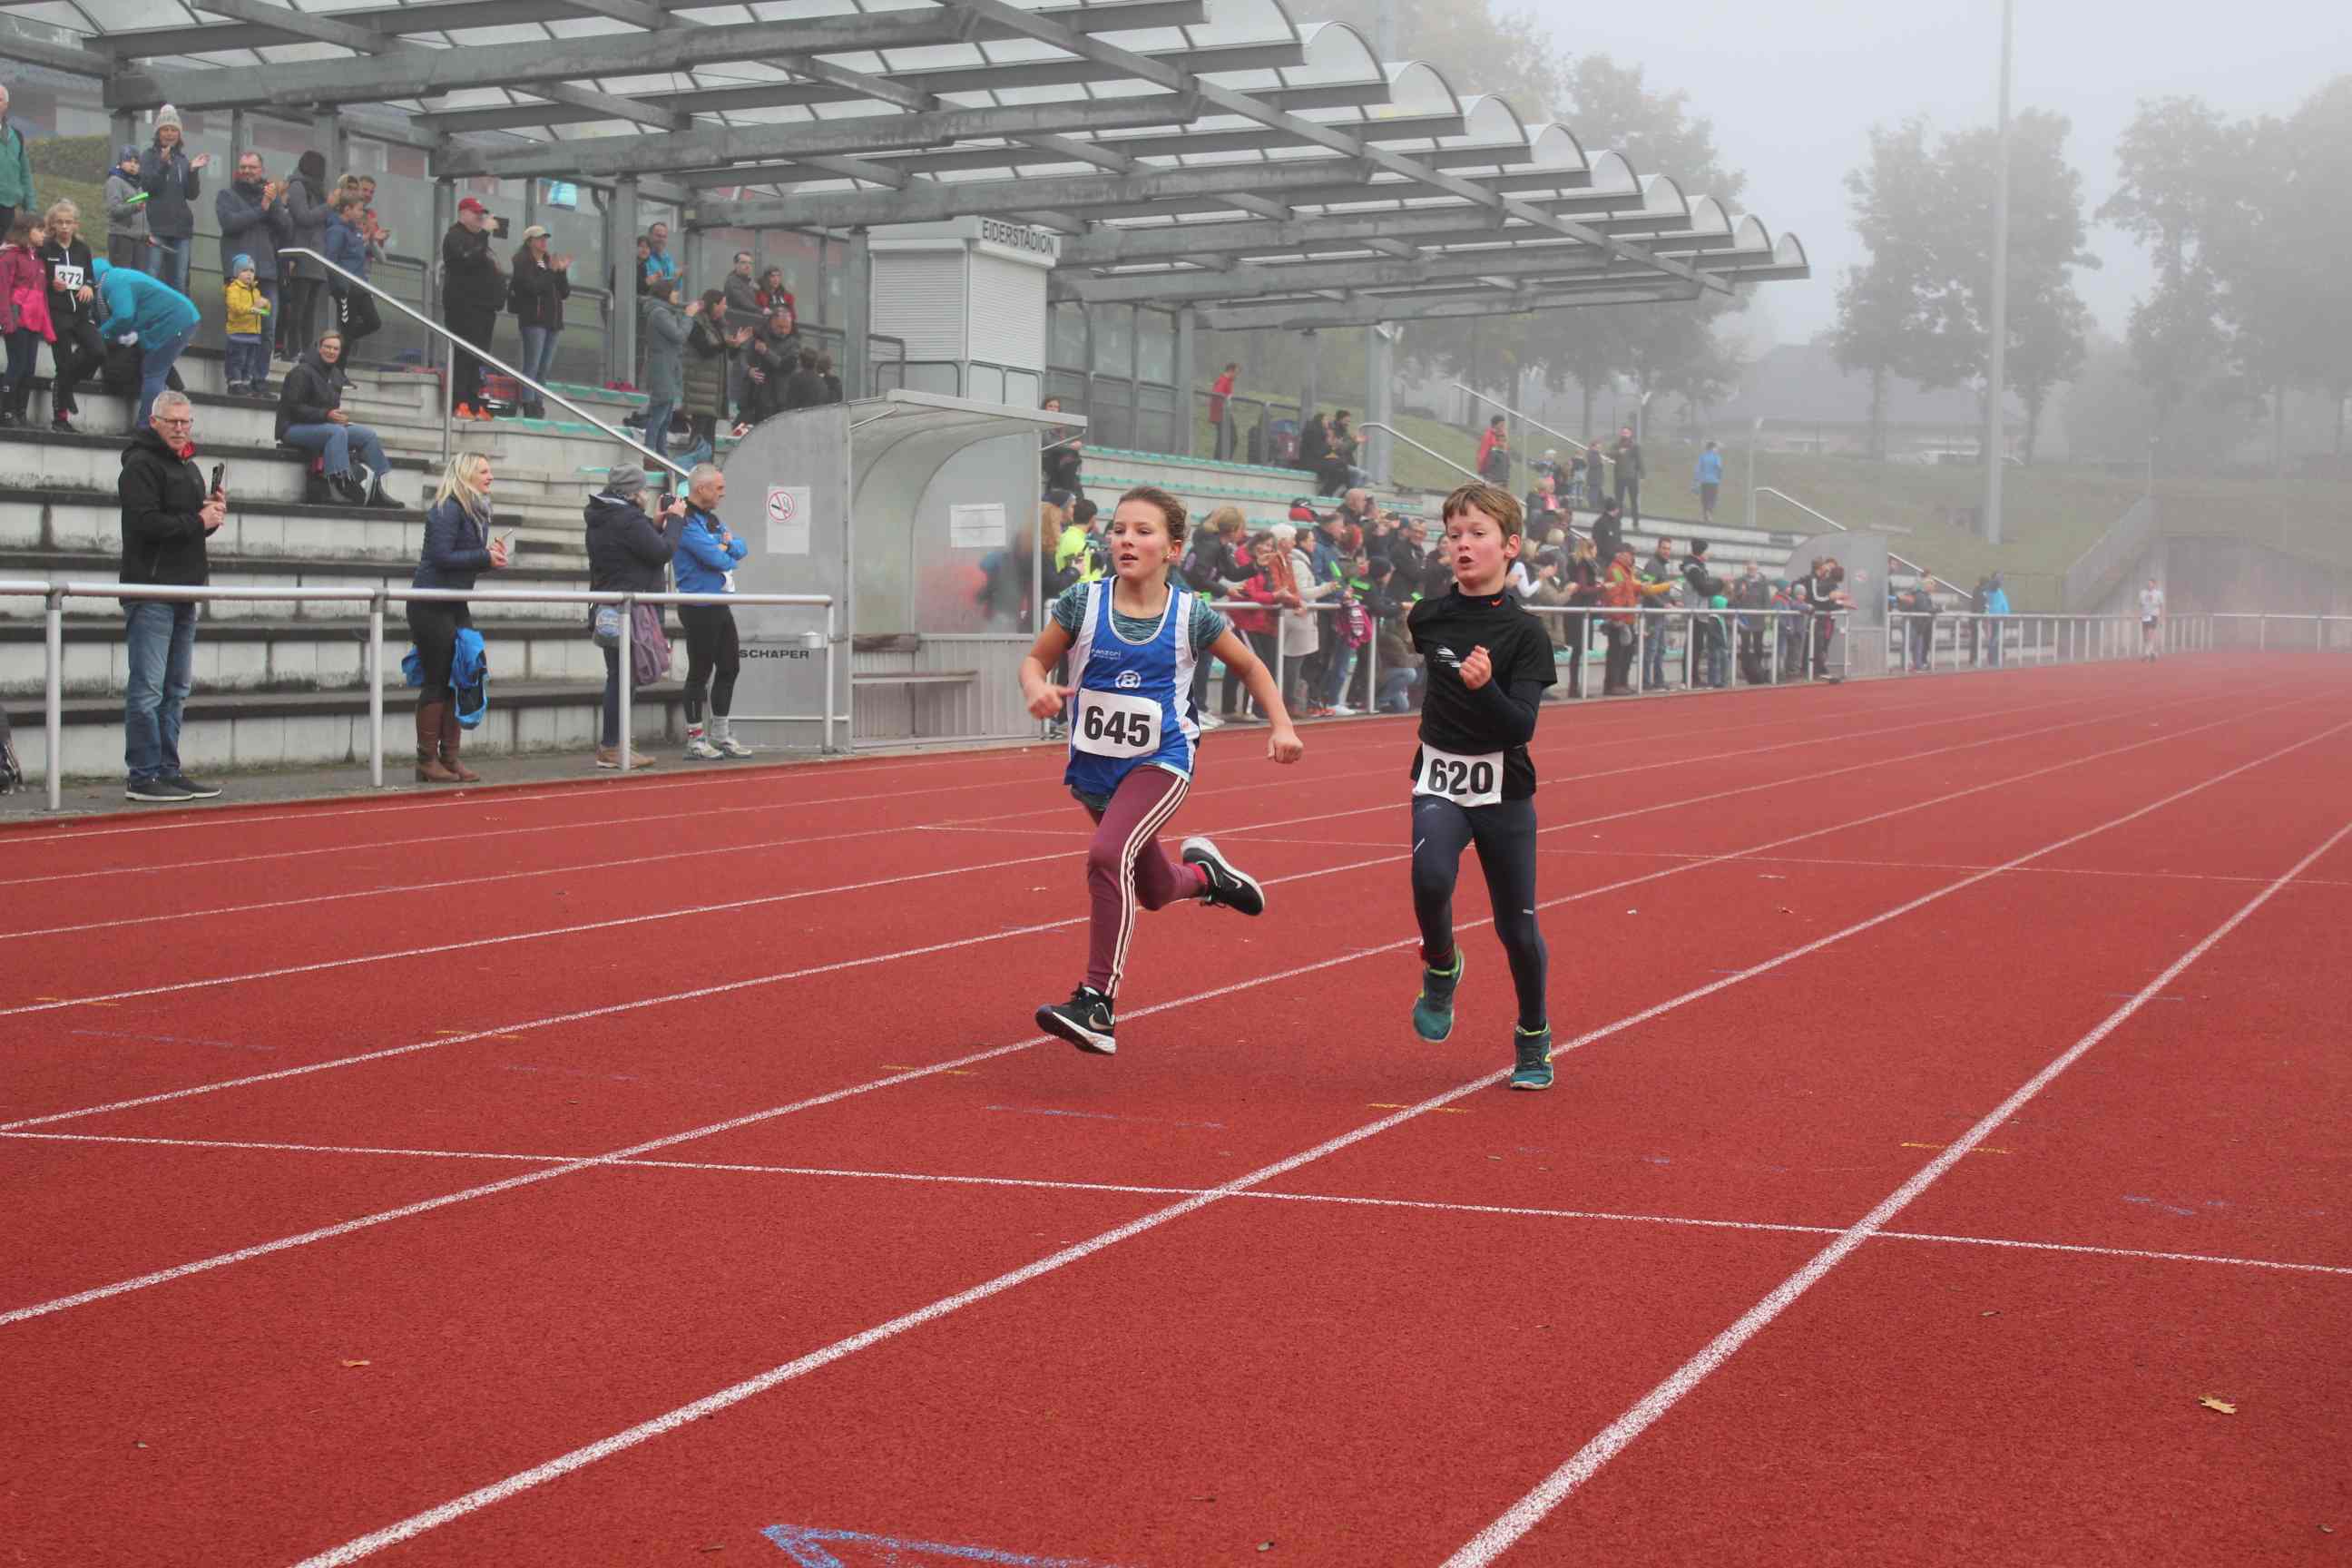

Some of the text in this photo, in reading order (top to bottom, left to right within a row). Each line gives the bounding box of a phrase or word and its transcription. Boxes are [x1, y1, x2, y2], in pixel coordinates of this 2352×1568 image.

[982, 220, 1053, 255] EIDERSTADION
[1083, 705, 1151, 748] 645
[1427, 758, 1494, 795] 620
